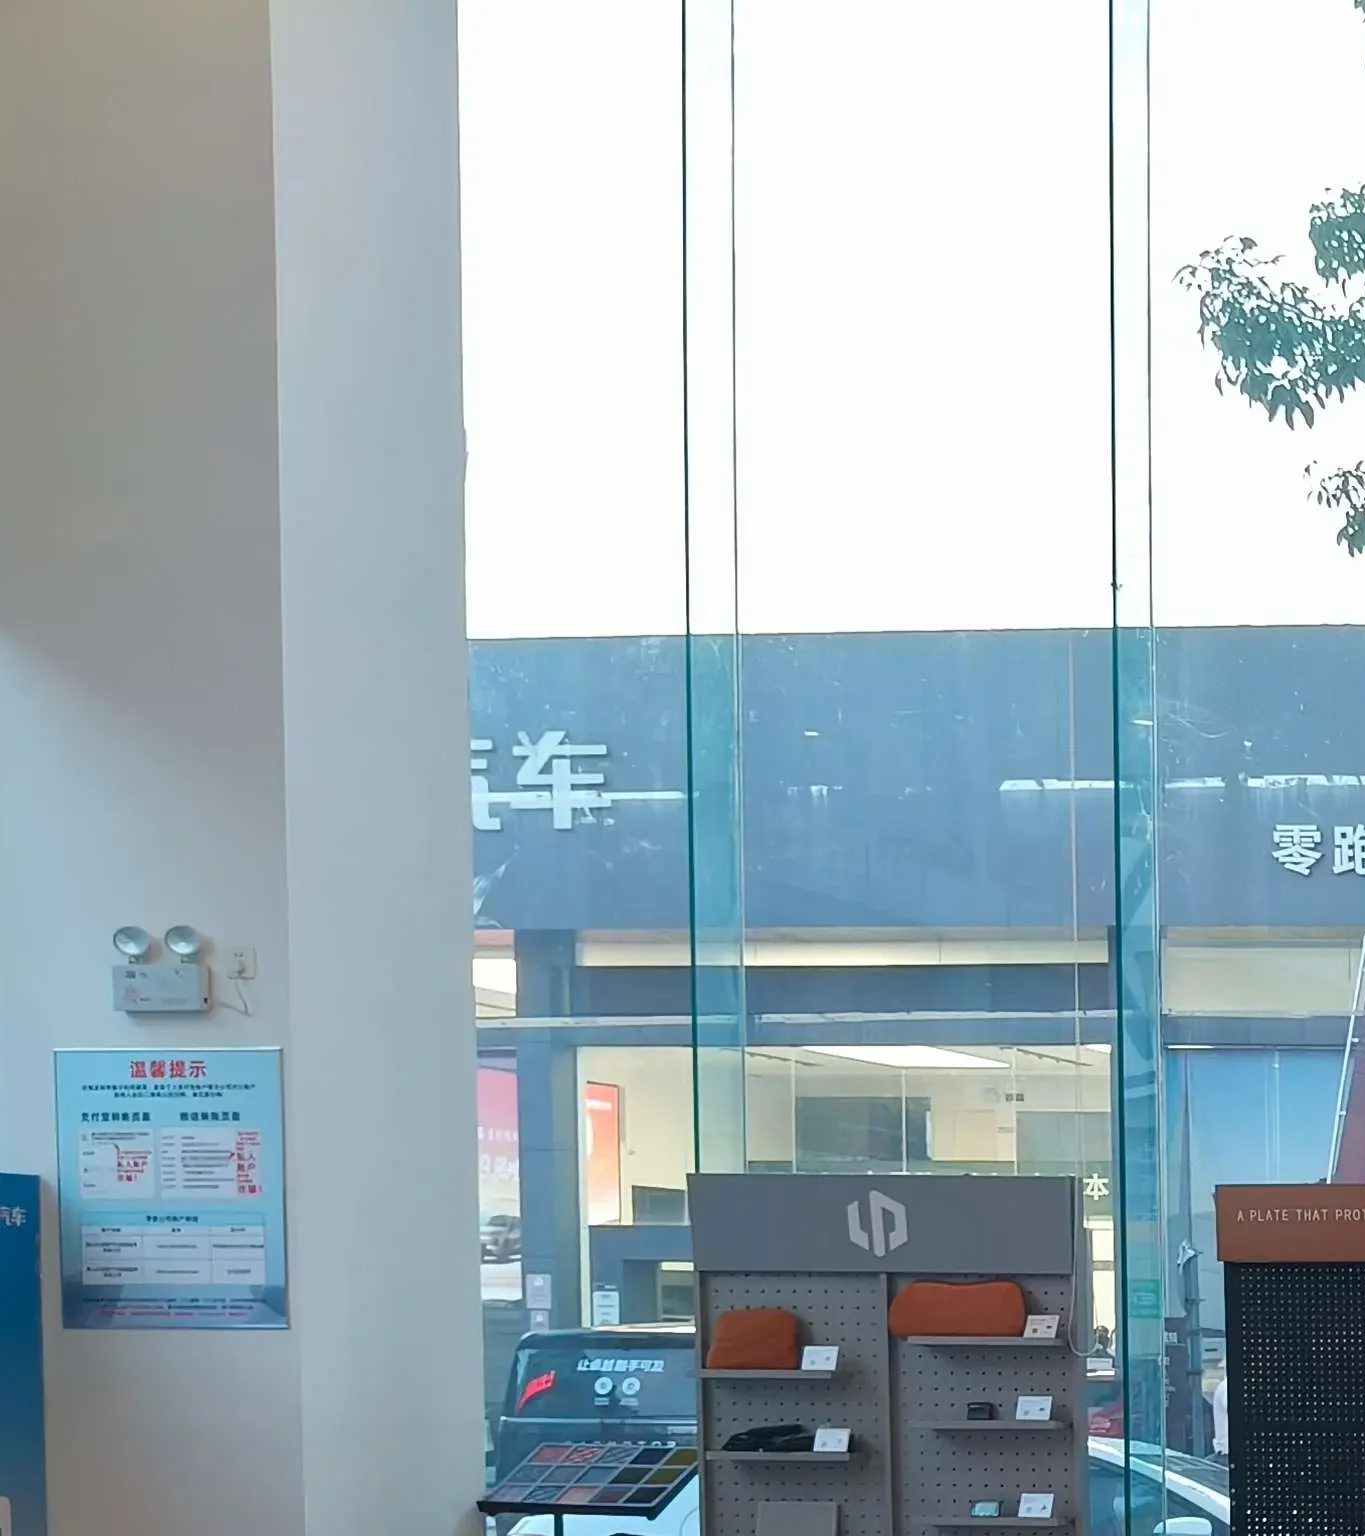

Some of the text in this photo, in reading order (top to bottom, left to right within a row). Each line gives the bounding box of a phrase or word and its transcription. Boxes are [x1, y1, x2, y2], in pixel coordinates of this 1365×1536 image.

[130, 1060, 207, 1078] 温馨提示
[1237, 1210, 1245, 1222] A
[1250, 1208, 1289, 1222] PLATE
[1296, 1208, 1329, 1222] THAT
